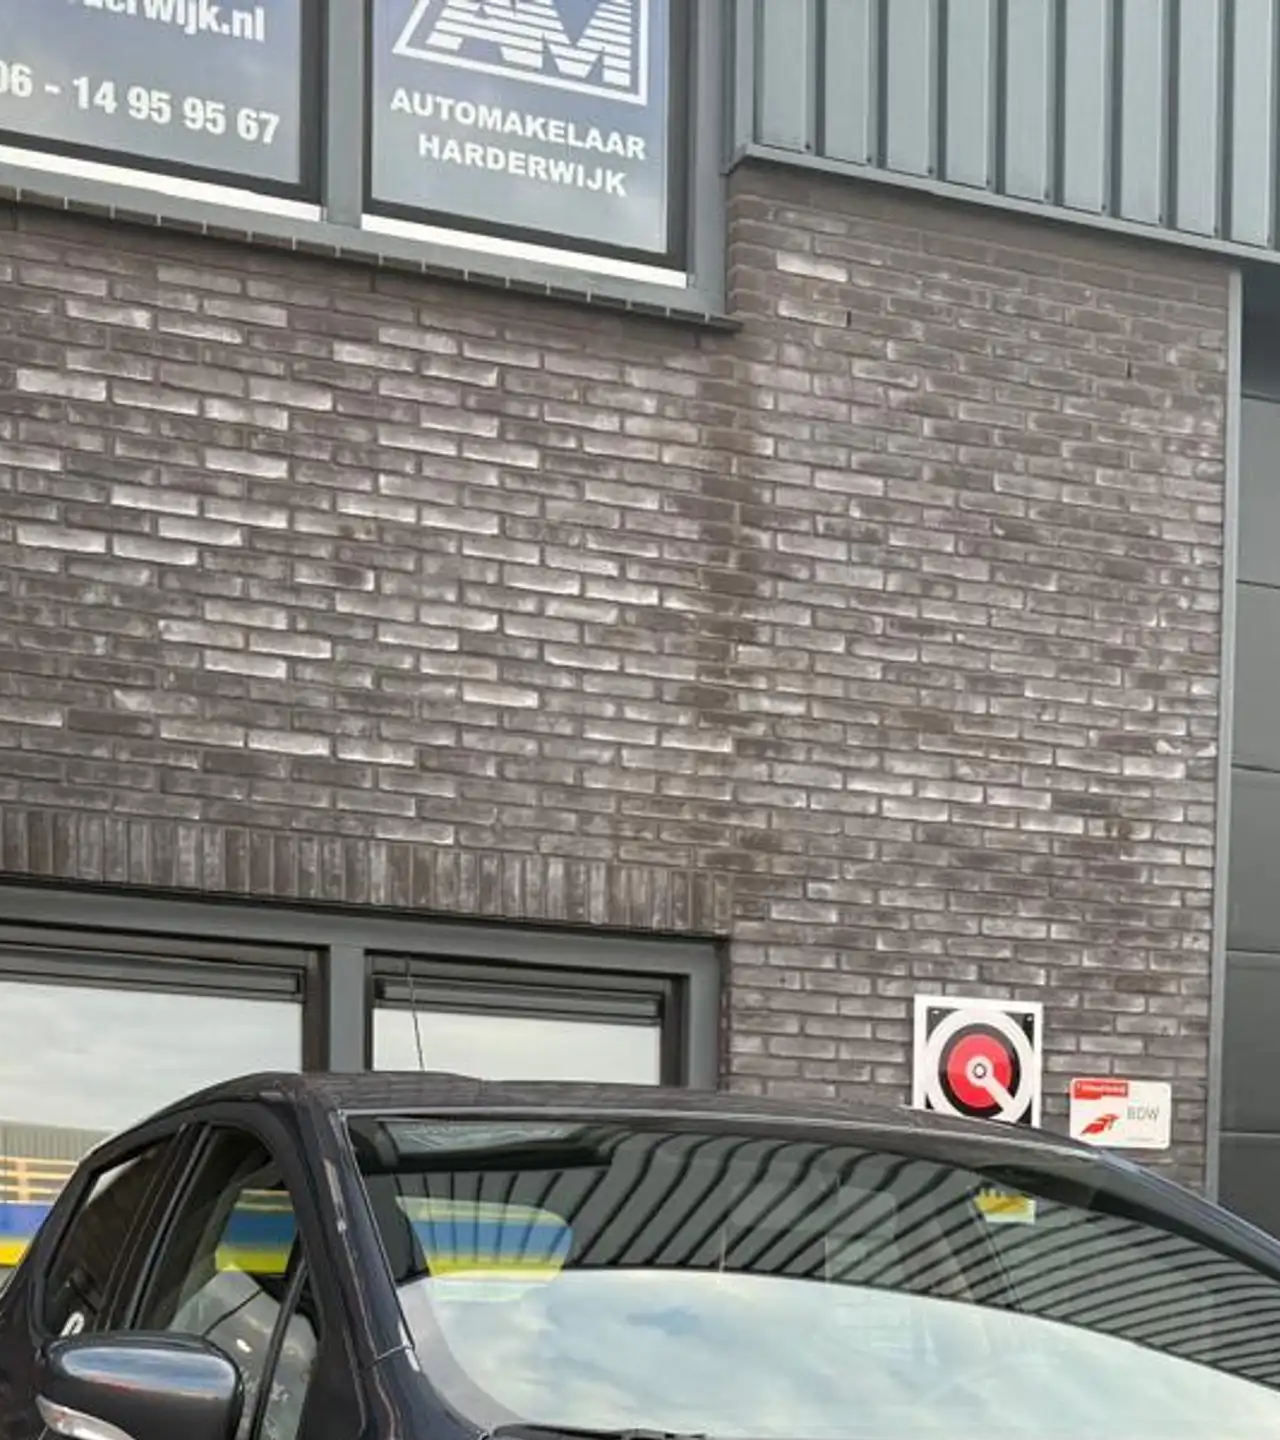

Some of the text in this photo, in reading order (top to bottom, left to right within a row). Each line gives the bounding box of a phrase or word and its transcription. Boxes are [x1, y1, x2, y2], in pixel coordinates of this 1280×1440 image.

[72, 75, 118, 114] 14
[127, 86, 171, 125] 95
[183, 96, 226, 136] 95
[236, 107, 280, 145] 67
[389, 87, 647, 160] AUTOMAKELAAR
[418, 133, 629, 198] HARDERWIJK
